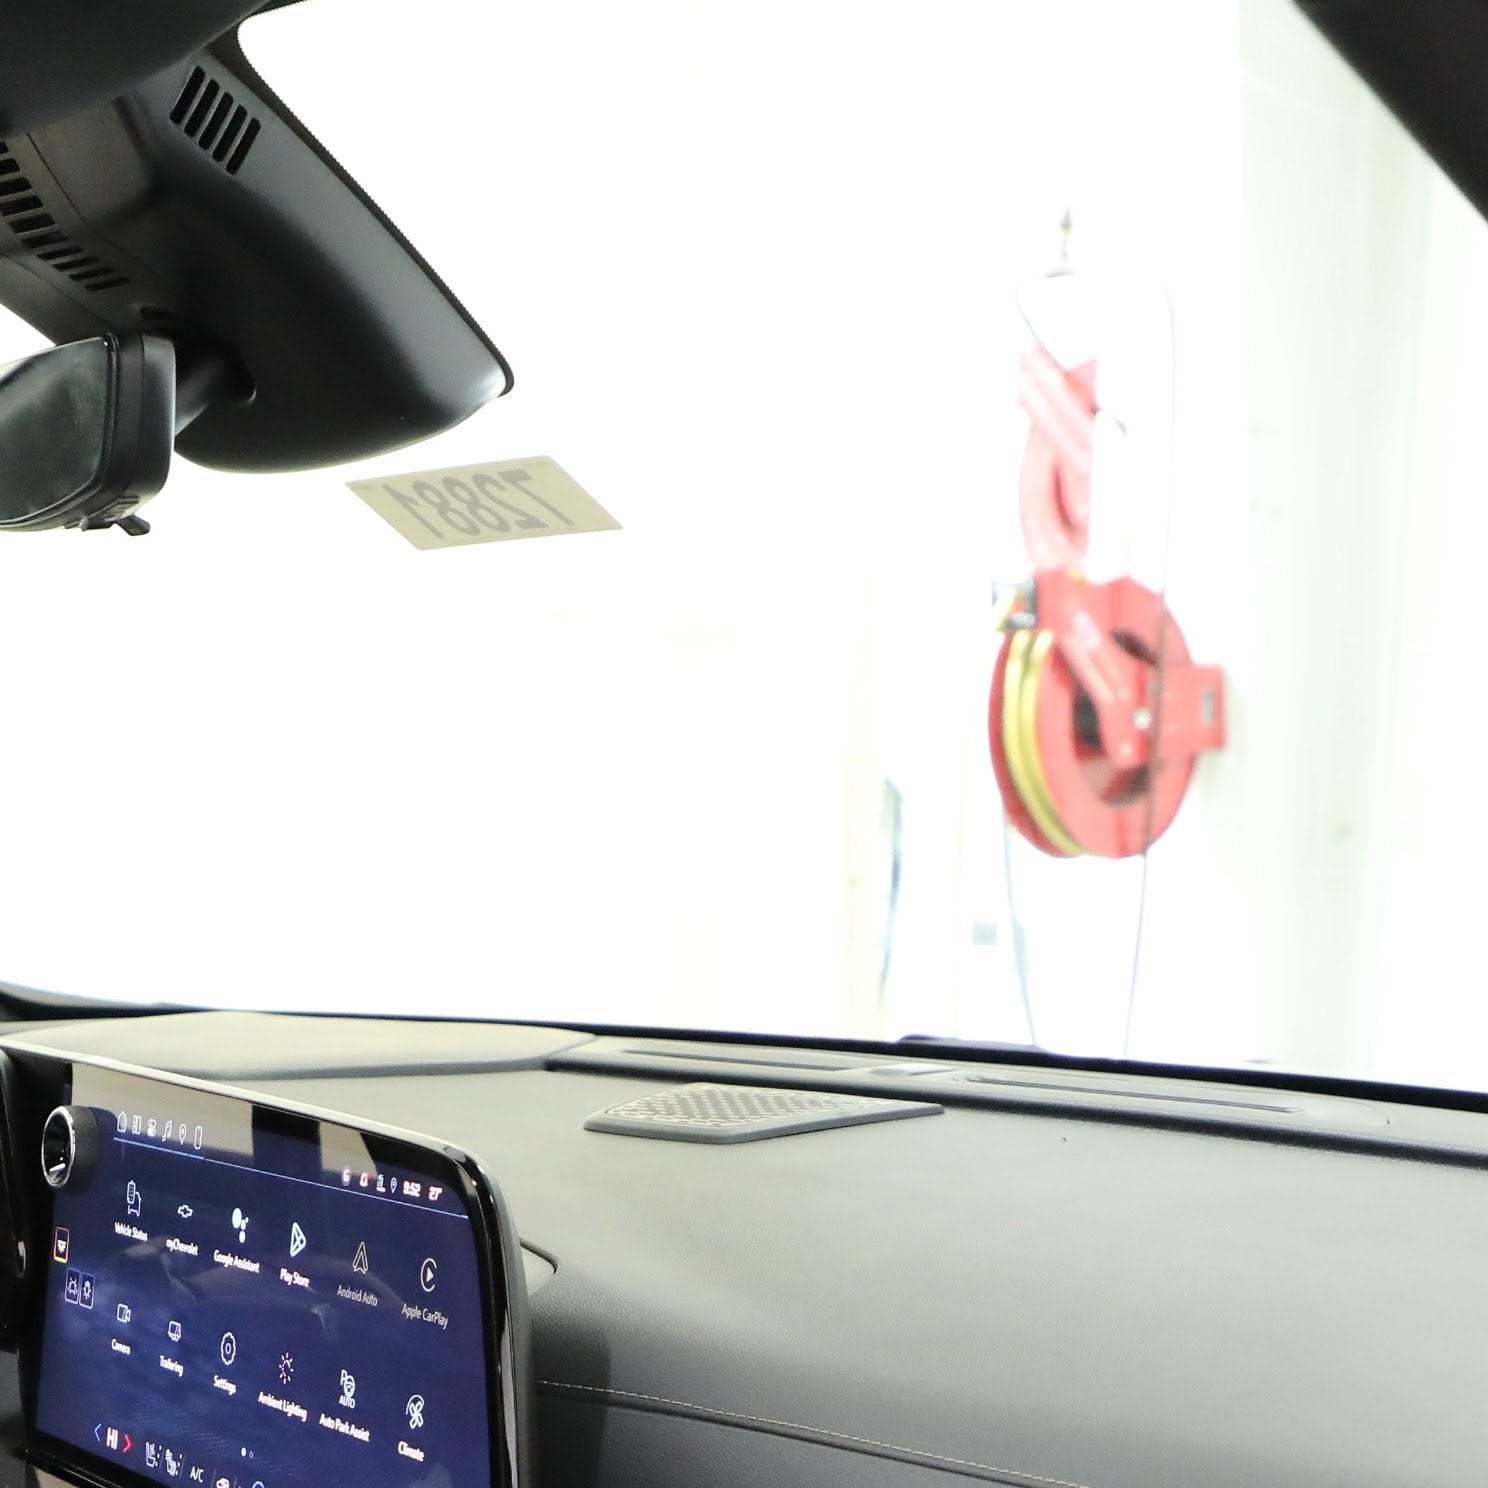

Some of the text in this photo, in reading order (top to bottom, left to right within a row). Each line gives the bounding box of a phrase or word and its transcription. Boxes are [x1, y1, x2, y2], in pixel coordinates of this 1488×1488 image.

[402, 1181, 422, 1197] 9:52
[114, 1222, 148, 1242] Vehicle Status
[166, 1238, 198, 1256] myChevrolet
[214, 1250, 260, 1274] Google Assistant
[280, 1268, 310, 1288] Play Store
[337, 1284, 378, 1306] Android Auto
[402, 1302, 449, 1330] Apple CarPlay
[112, 1338, 130, 1355] Camera
[160, 1355, 184, 1378] Trailering
[214, 1374, 236, 1396] Settings
[258, 1391, 308, 1423] Ambient Lighting
[338, 1395, 356, 1409] AUTO
[106, 1426, 118, 1450] HI
[319, 1414, 370, 1442] Auto Park Assist
[398, 1441, 425, 1462] Climate
[190, 1466, 204, 1483] A/C
